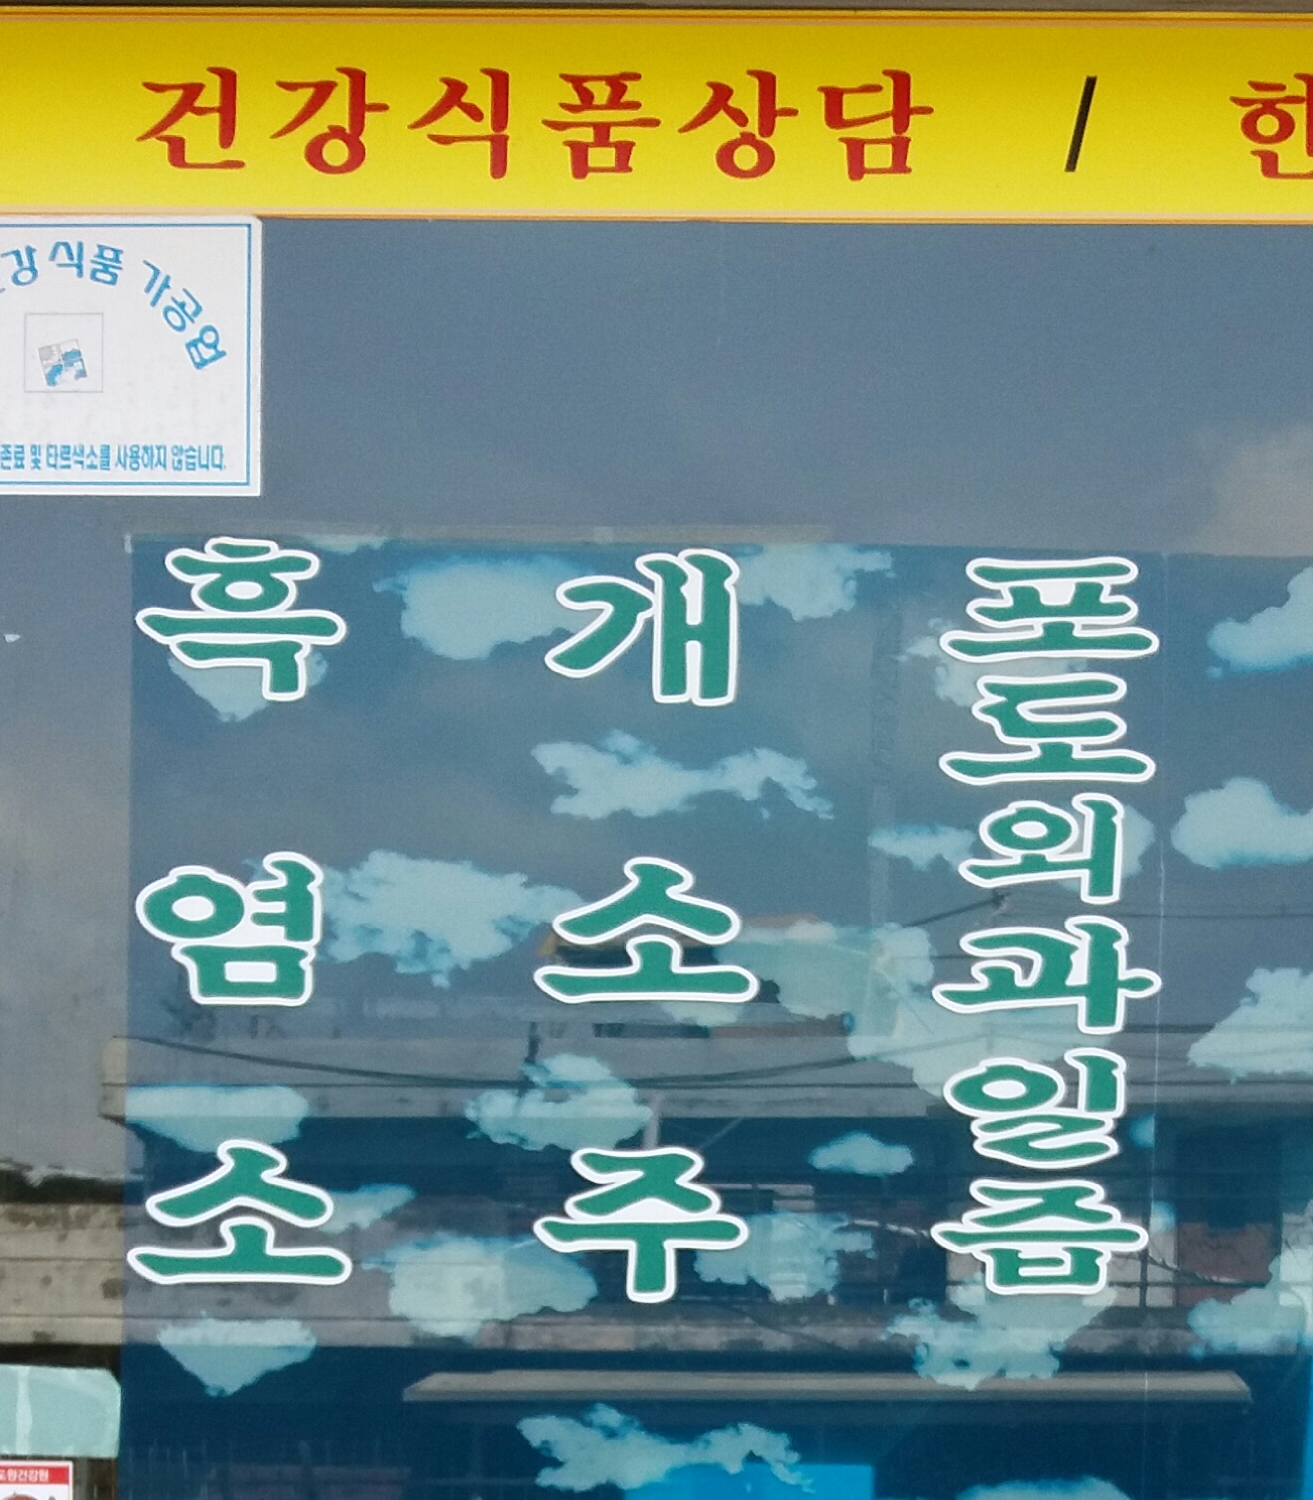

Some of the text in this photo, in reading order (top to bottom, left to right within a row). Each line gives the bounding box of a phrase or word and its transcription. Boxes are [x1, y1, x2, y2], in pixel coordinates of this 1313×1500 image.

[135, 64, 937, 182] 건강식품상담
[142, 259, 227, 370] 가공업
[114, 443, 168, 472] 사용하지
